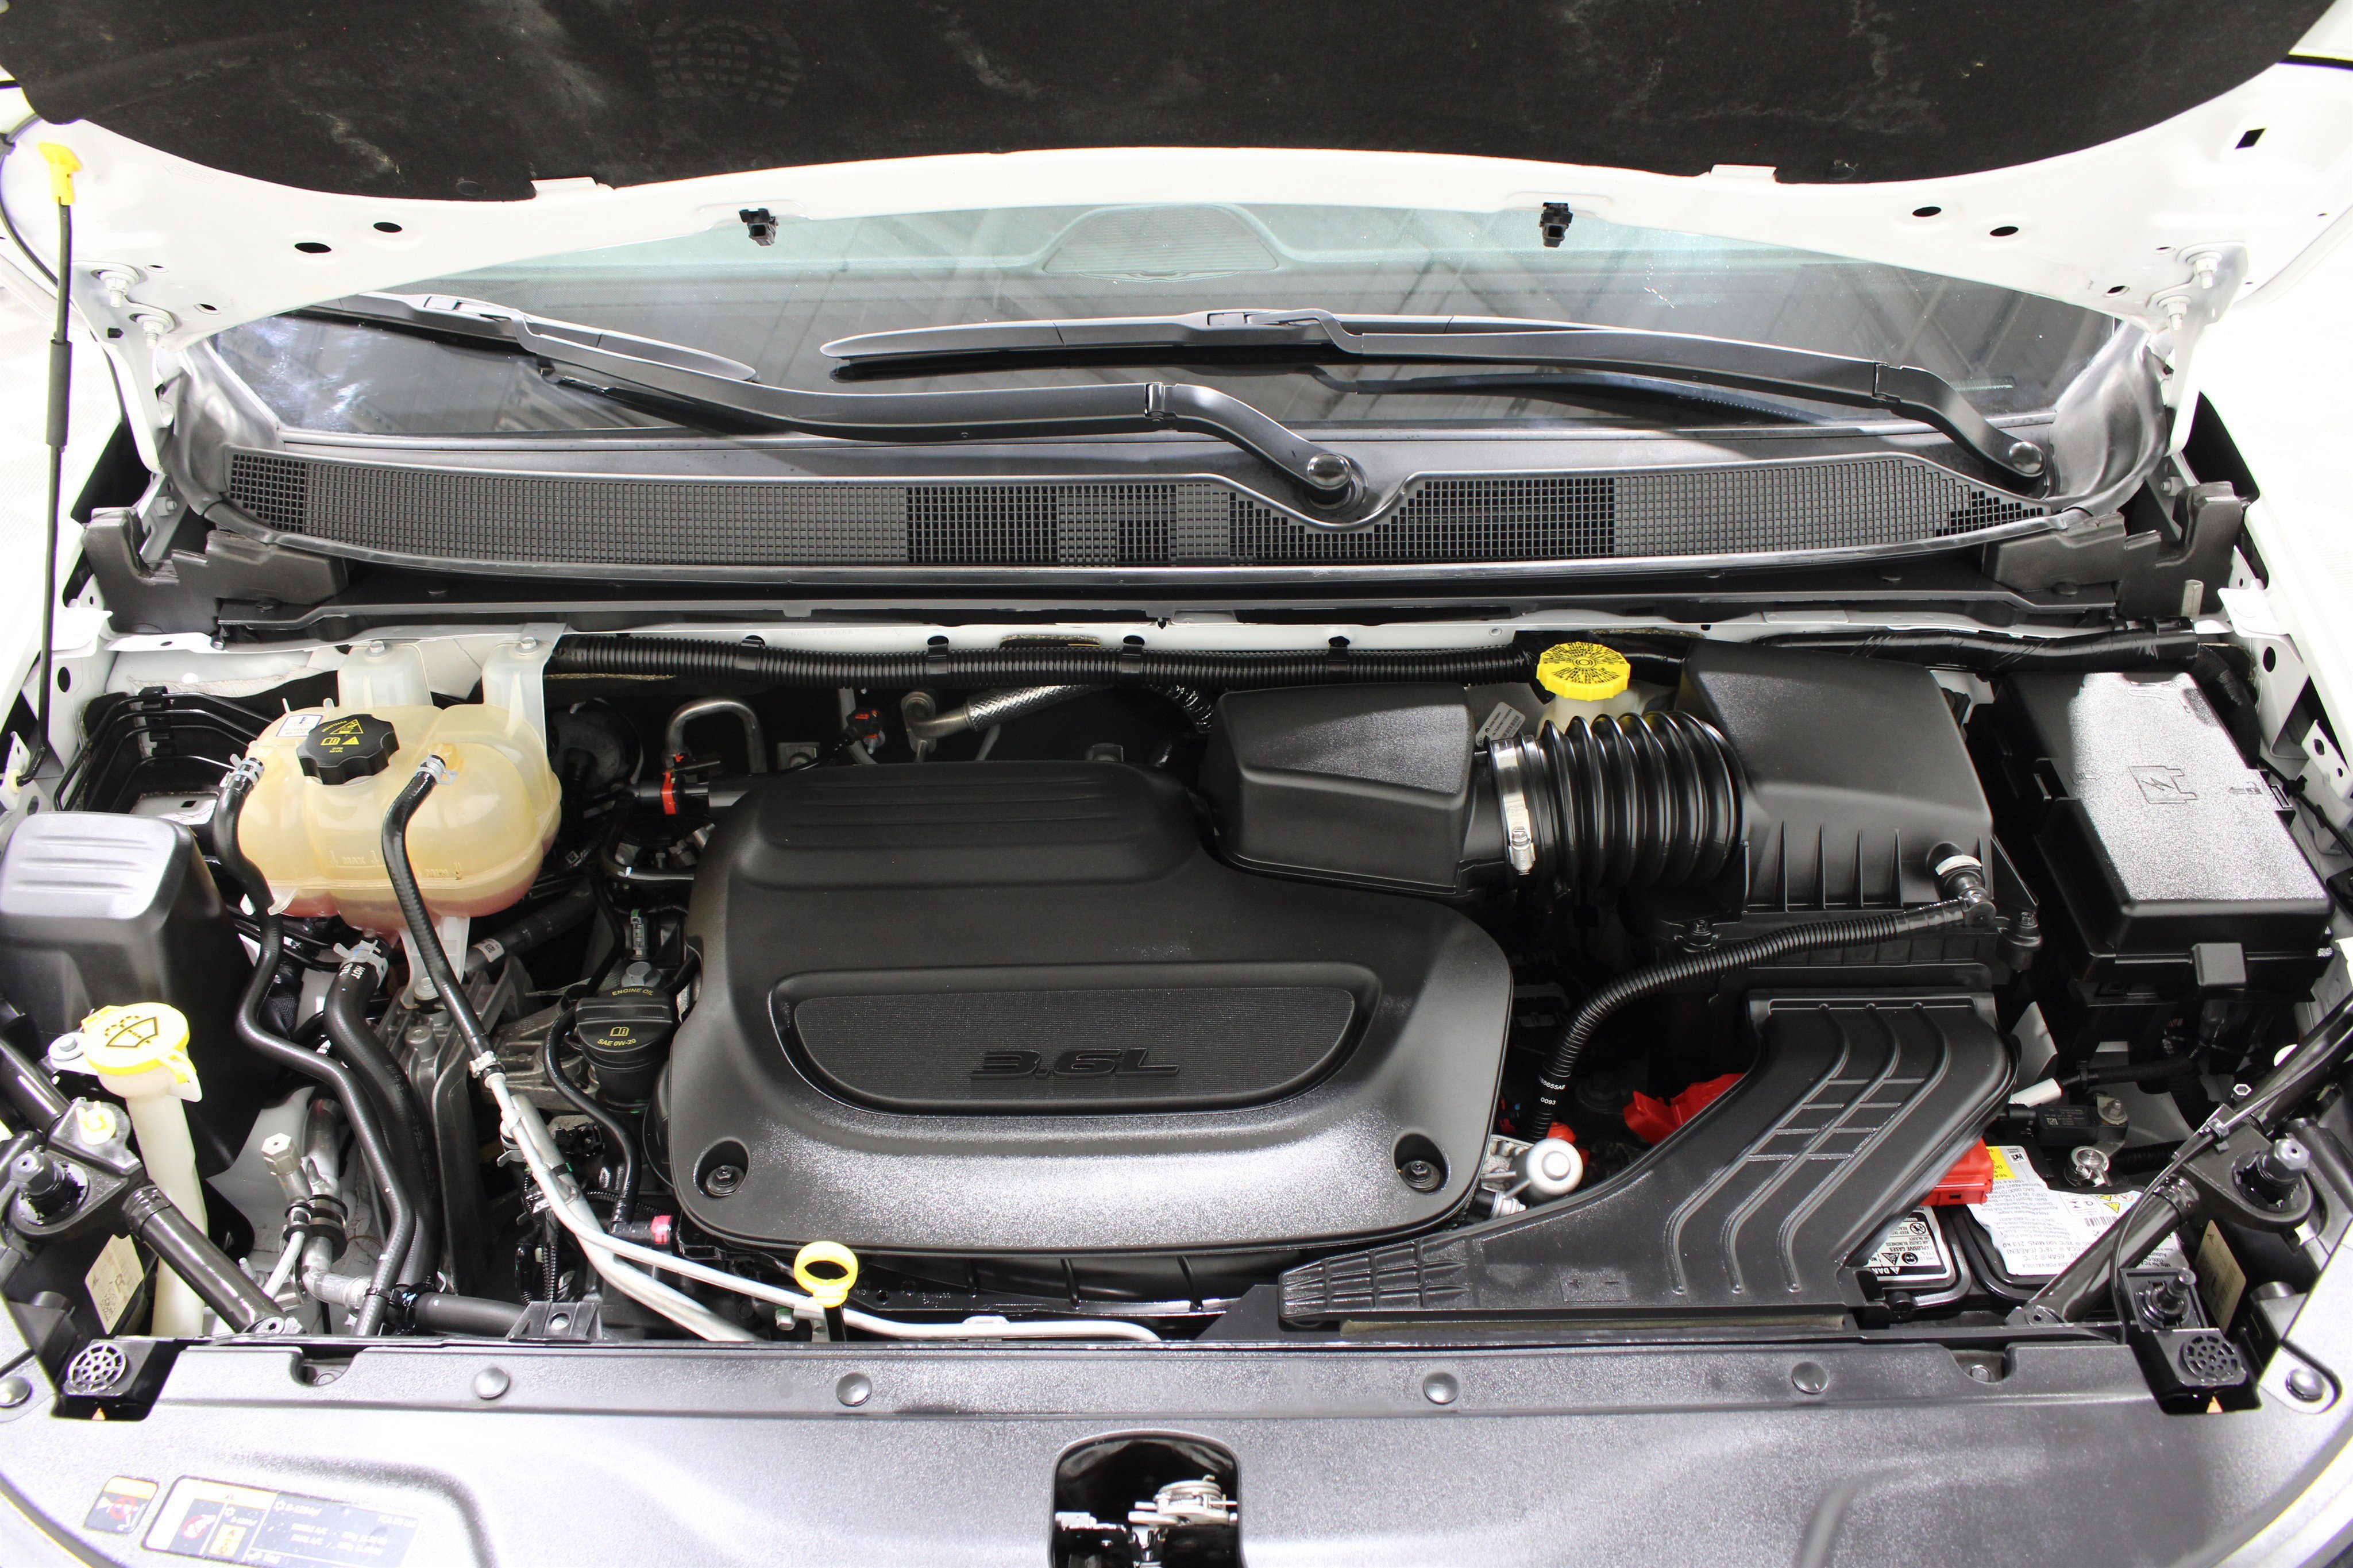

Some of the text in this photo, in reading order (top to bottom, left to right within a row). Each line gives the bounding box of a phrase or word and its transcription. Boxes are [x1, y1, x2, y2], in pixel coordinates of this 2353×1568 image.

[342, 856, 366, 864] MAX
[351, 965, 365, 979] HOT
[612, 988, 653, 996] ENGINE OIL
[614, 1038, 637, 1046] 0W-20
[970, 1048, 1179, 1079] 3.6L
